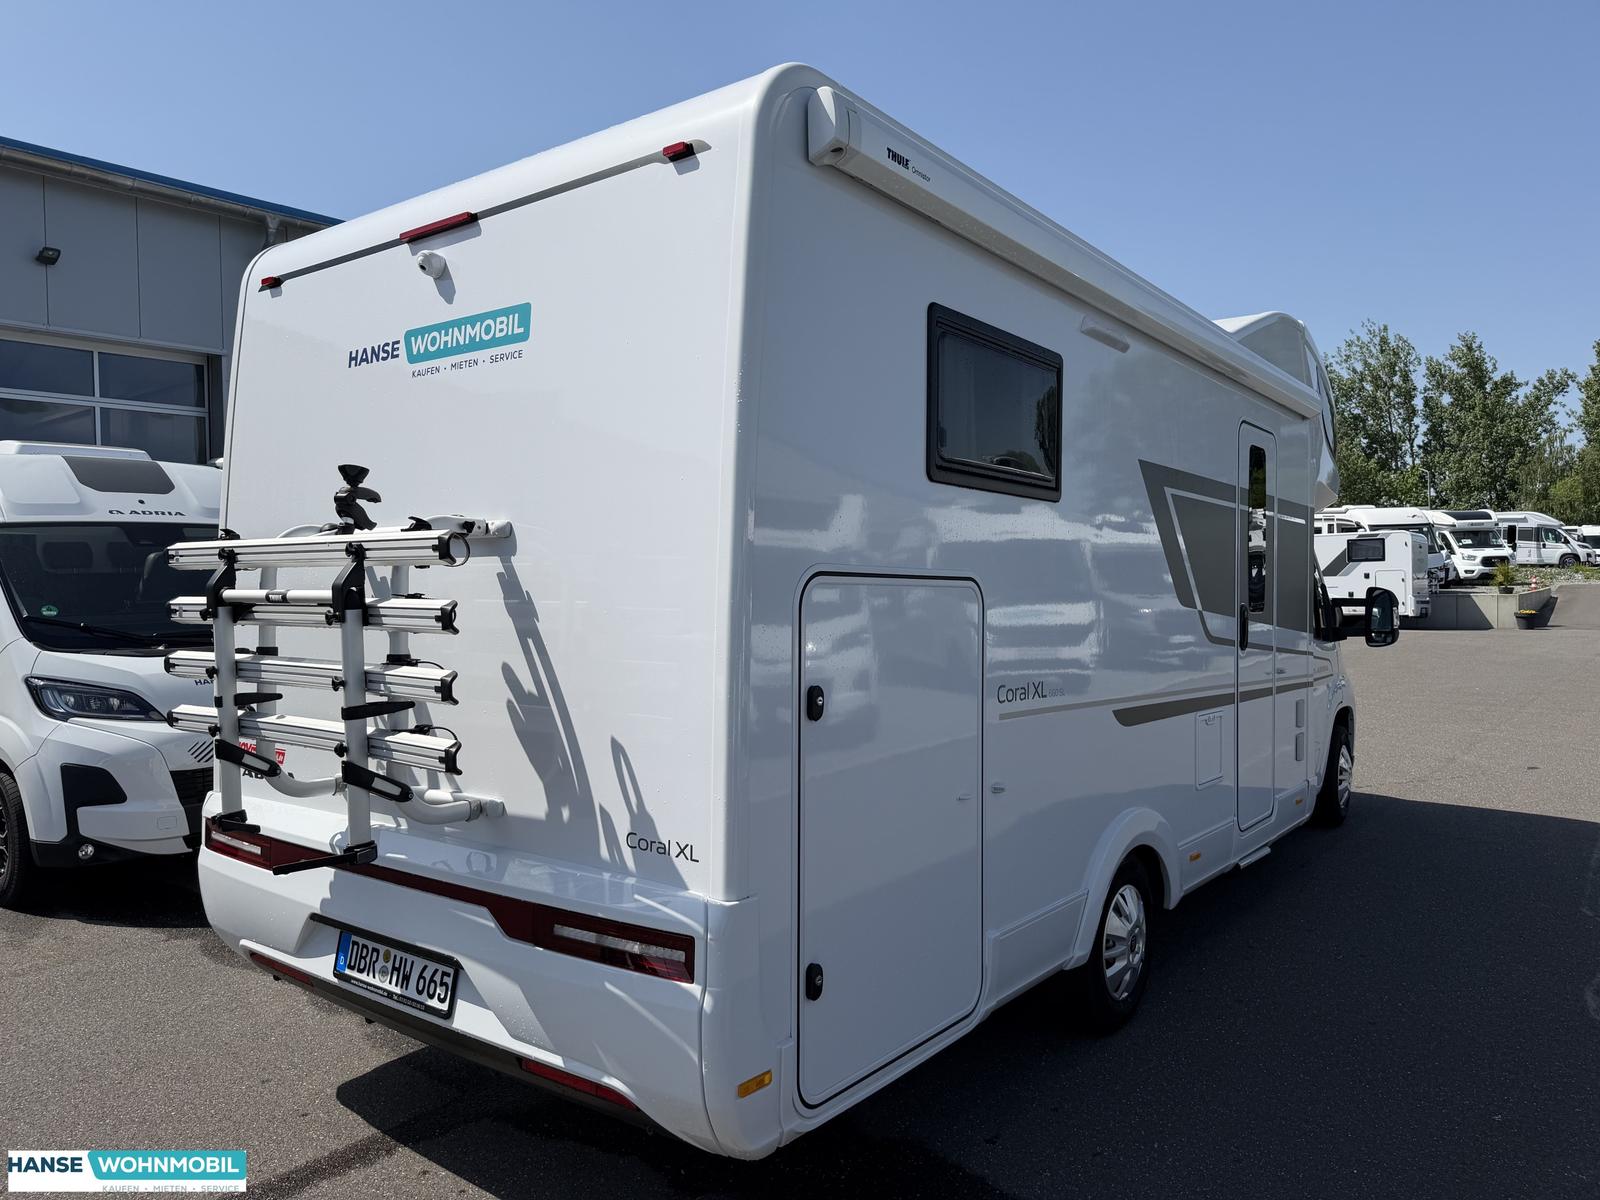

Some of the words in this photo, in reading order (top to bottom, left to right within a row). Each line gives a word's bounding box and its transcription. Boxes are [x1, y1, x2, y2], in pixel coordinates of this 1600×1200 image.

[887, 147, 910, 170] THULE
[348, 340, 400, 368] HANSE
[410, 313, 525, 355] WOHNMOBIL
[411, 365, 441, 379] KAUFEN
[450, 358, 479, 372] MIETEN
[489, 349, 524, 364] SERVICE
[997, 682, 1030, 704] Coral
[1031, 680, 1047, 699] XL
[626, 832, 670, 856] Coral
[675, 841, 699, 863] XL
[347, 940, 380, 979] DBR
[389, 954, 414, 991] HW
[416, 964, 451, 1004] 665
